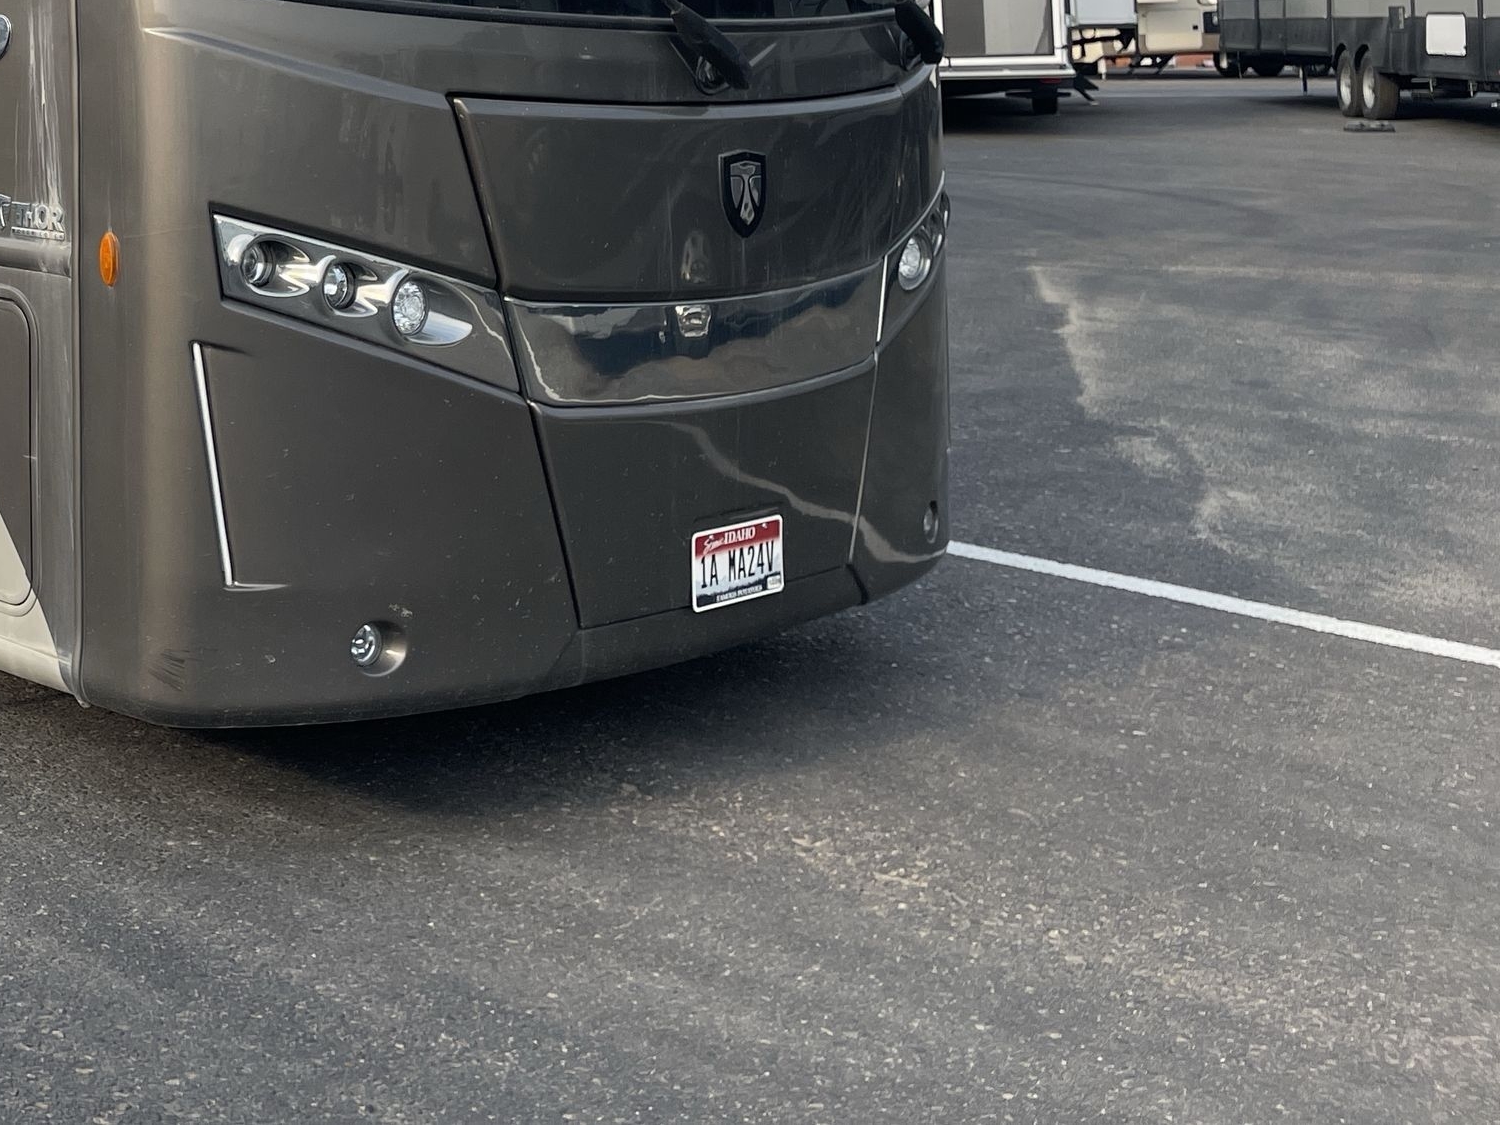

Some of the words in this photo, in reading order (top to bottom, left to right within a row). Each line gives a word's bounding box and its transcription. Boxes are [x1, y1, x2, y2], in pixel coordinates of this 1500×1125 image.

[723, 526, 756, 545] IDAHO
[701, 554, 719, 589] 1A
[728, 540, 775, 583] MA24V
